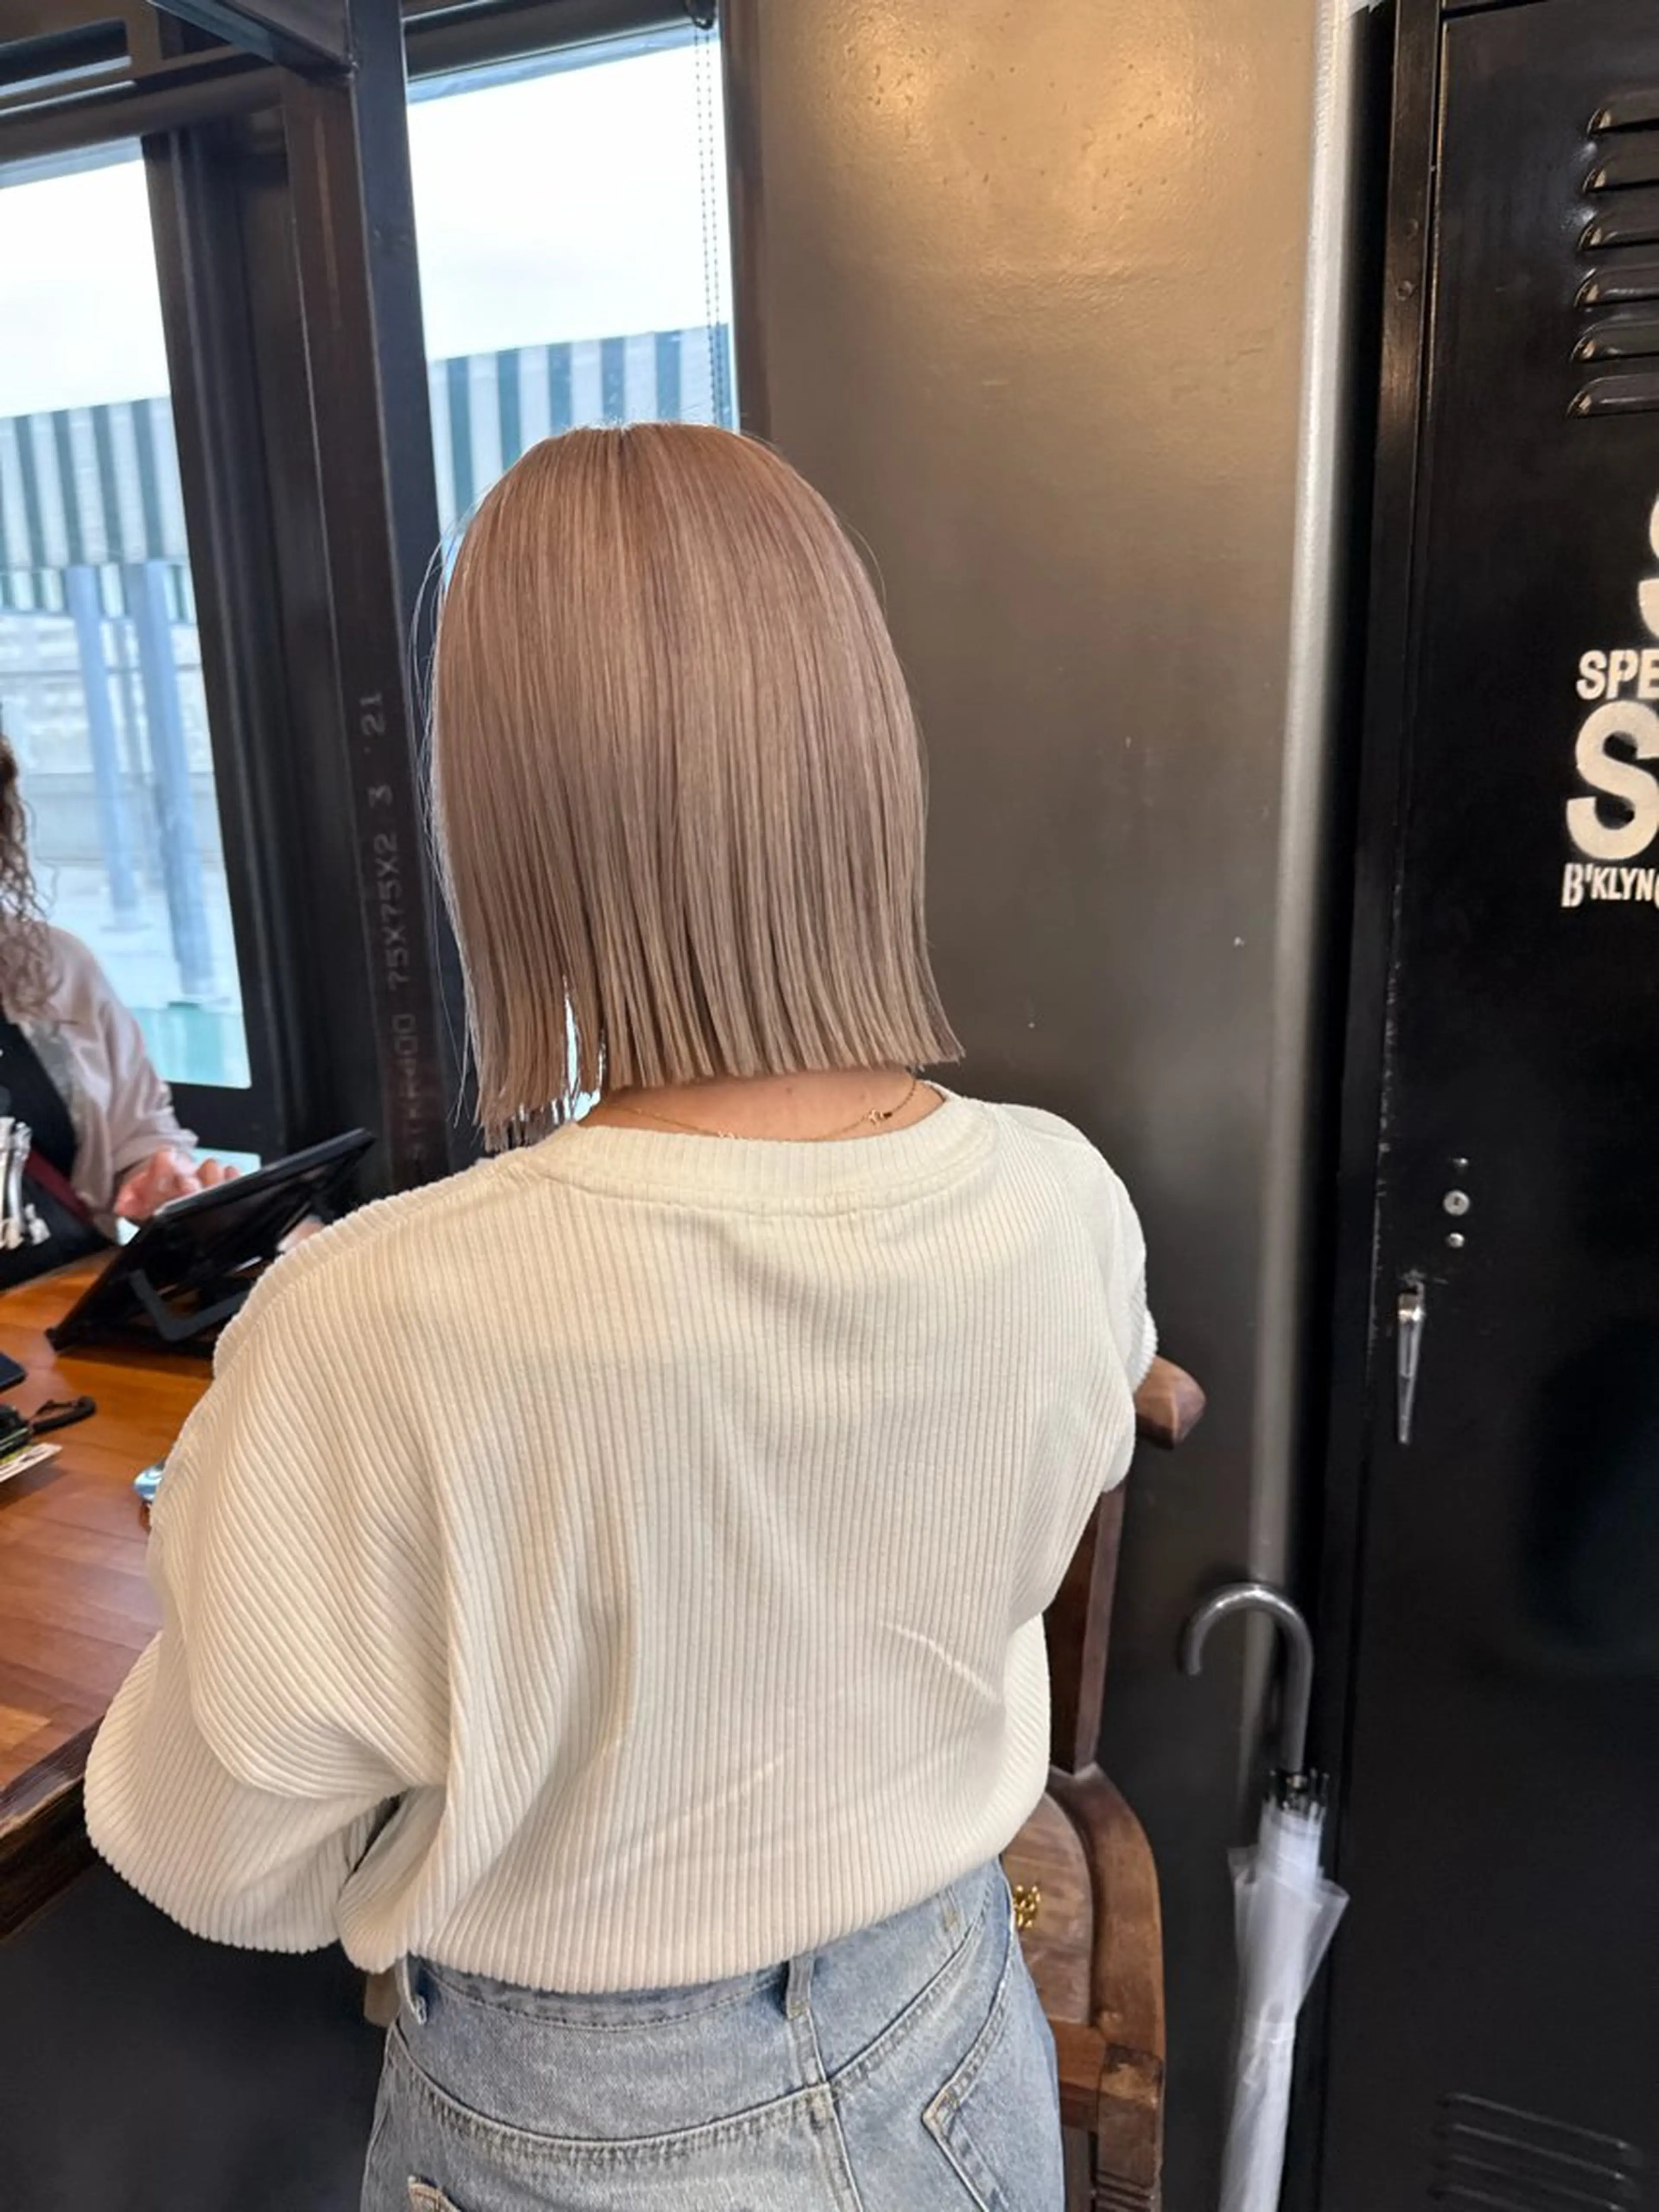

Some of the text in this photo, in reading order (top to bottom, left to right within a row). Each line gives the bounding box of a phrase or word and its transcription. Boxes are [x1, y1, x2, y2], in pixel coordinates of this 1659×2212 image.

[1576, 649, 1659, 700] SPE
[1566, 701, 1659, 860] S
[1561, 863, 1659, 910] B'KLYN
